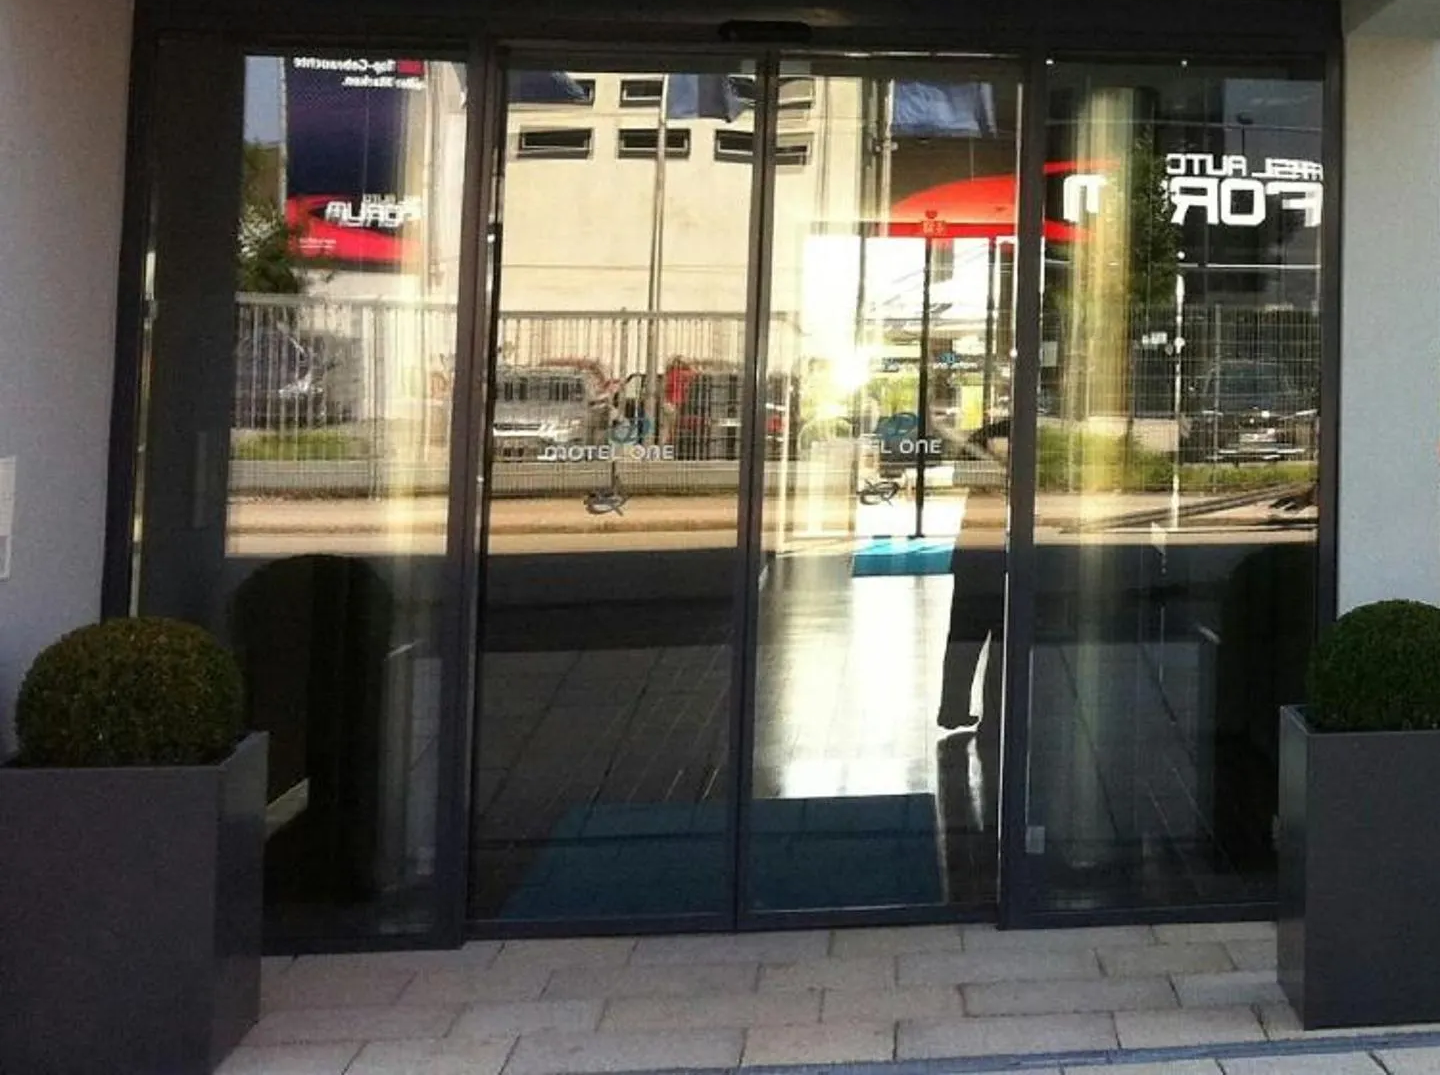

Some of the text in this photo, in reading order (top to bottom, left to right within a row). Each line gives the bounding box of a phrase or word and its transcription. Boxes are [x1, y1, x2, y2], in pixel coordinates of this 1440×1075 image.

[545, 444, 676, 461] MOTEL ONE
[899, 438, 943, 455] ONE
